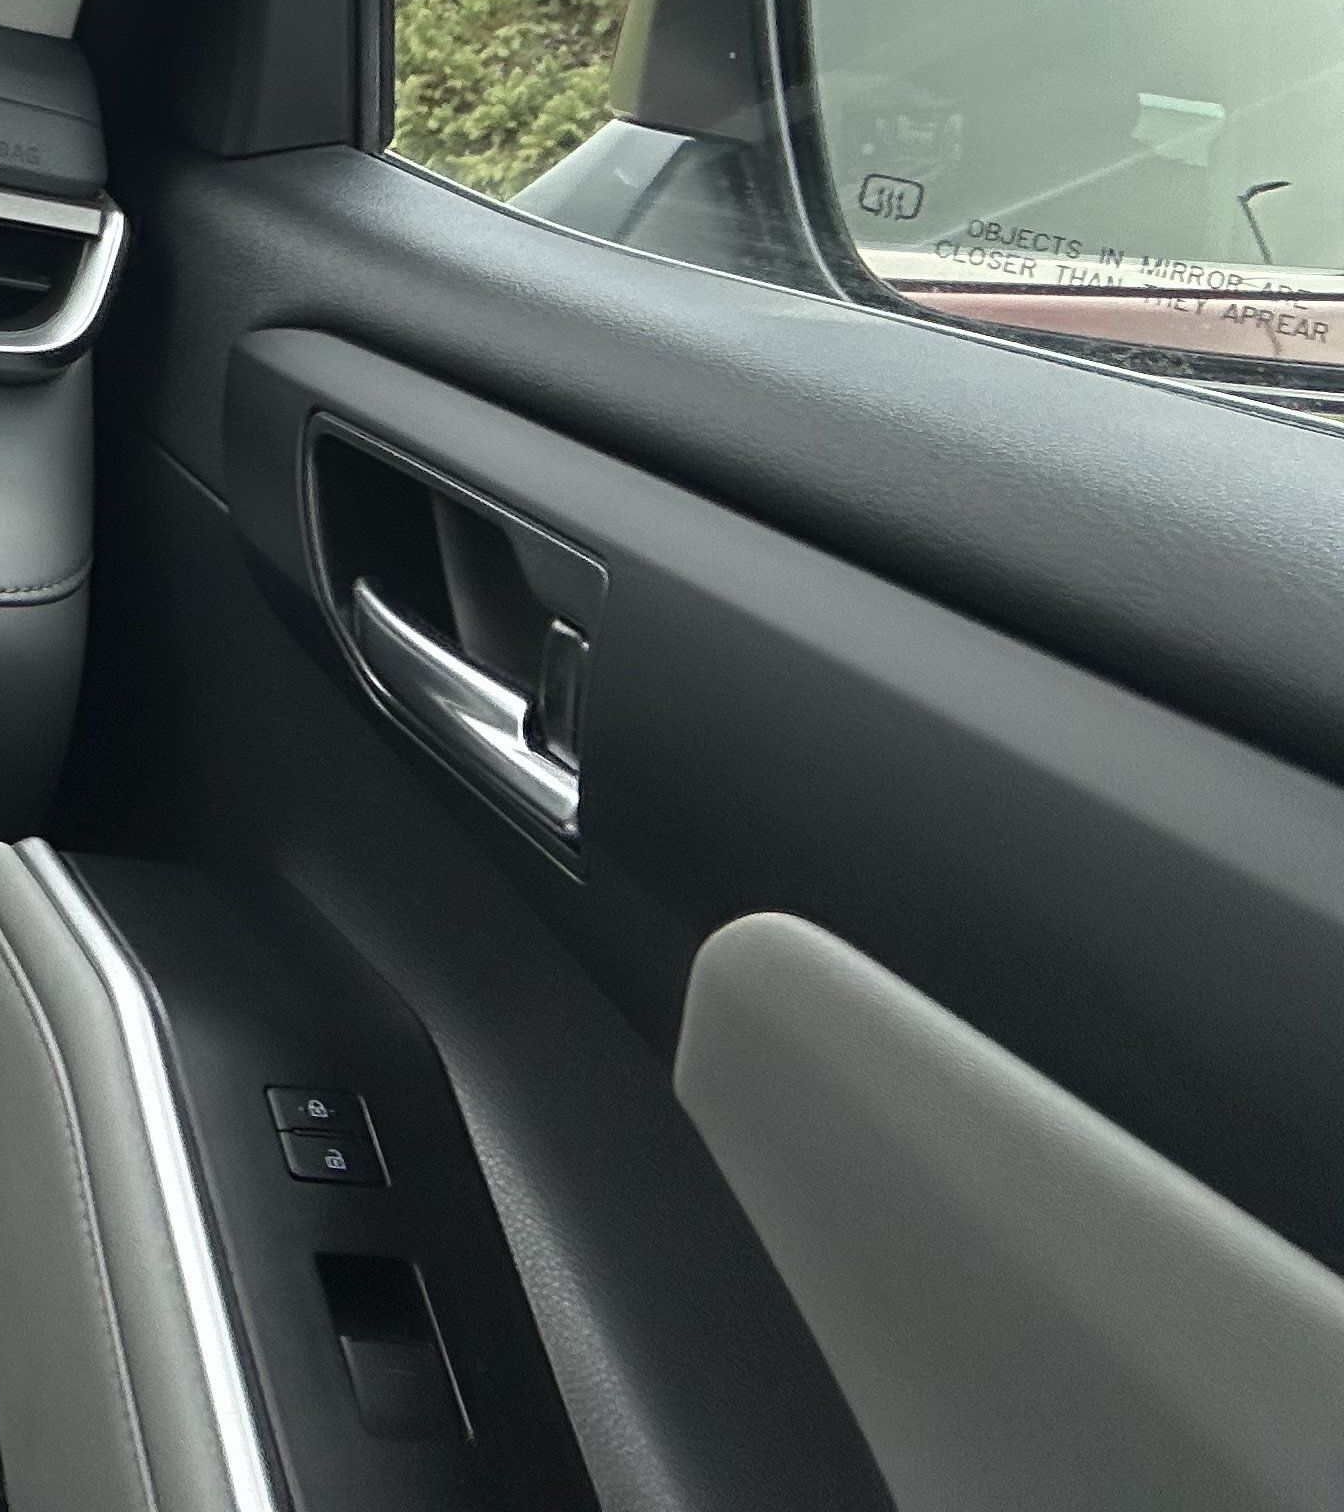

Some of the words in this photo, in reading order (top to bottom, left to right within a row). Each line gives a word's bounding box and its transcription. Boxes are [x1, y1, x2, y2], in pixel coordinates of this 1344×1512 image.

[935, 239, 1037, 279] CLOSER
[1219, 302, 1330, 344] APPEAR
[968, 219, 1083, 260] OBJECTS
[1099, 246, 1125, 268] IN
[1139, 254, 1244, 291] MIRROR
